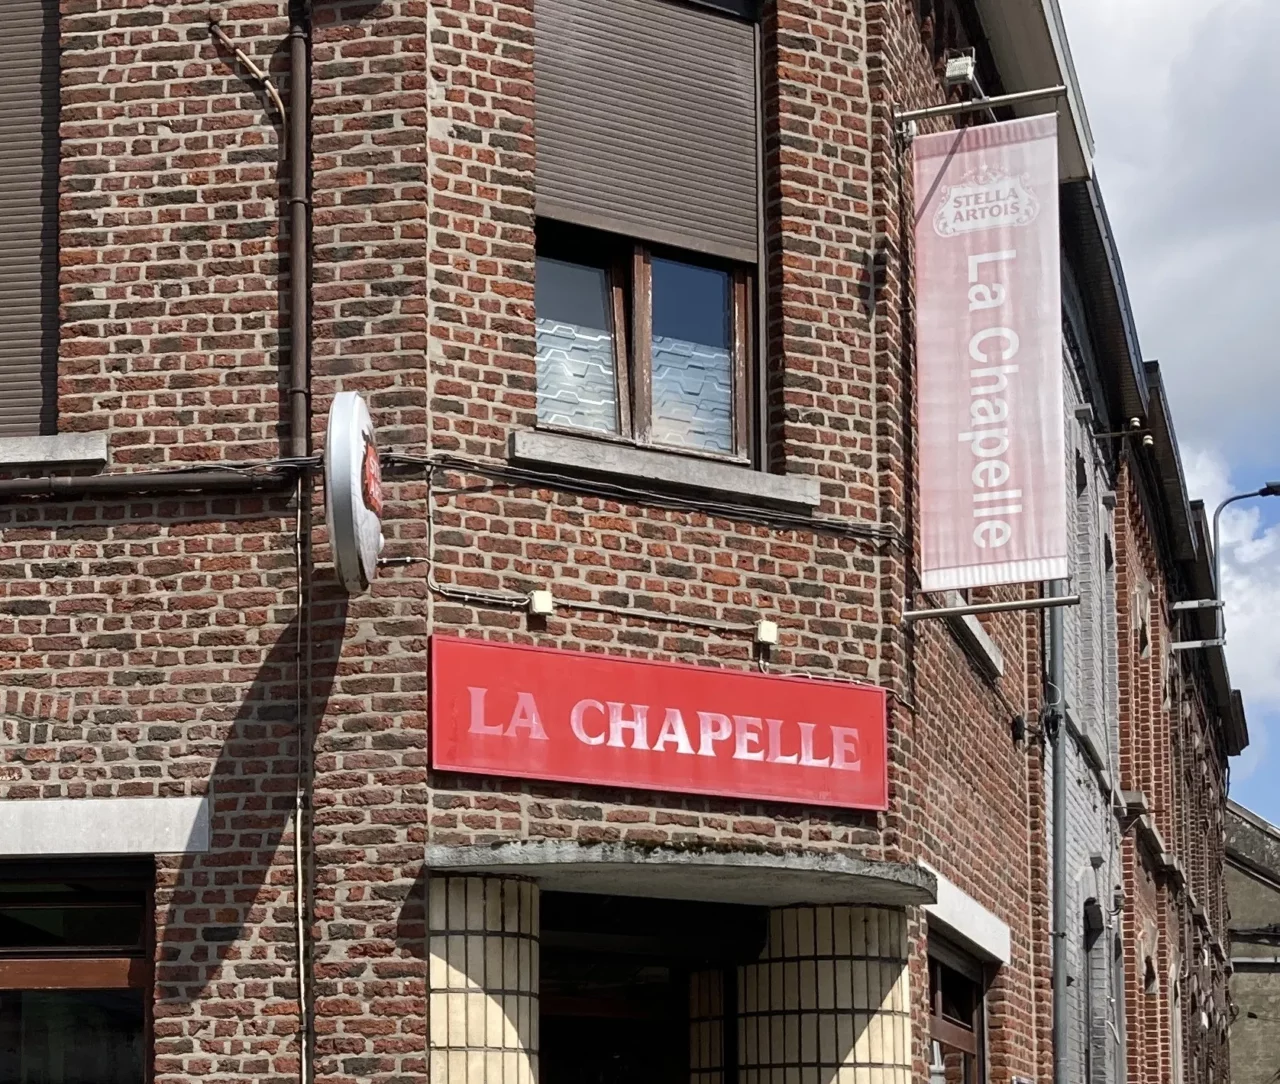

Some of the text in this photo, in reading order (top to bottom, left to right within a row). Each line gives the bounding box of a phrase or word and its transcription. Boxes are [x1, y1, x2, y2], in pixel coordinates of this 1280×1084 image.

[953, 188, 1019, 209] STELLA
[953, 201, 1020, 223] ARTOIS
[957, 249, 1023, 550] La Chapelle
[467, 686, 862, 773] LA CHAPELLE
